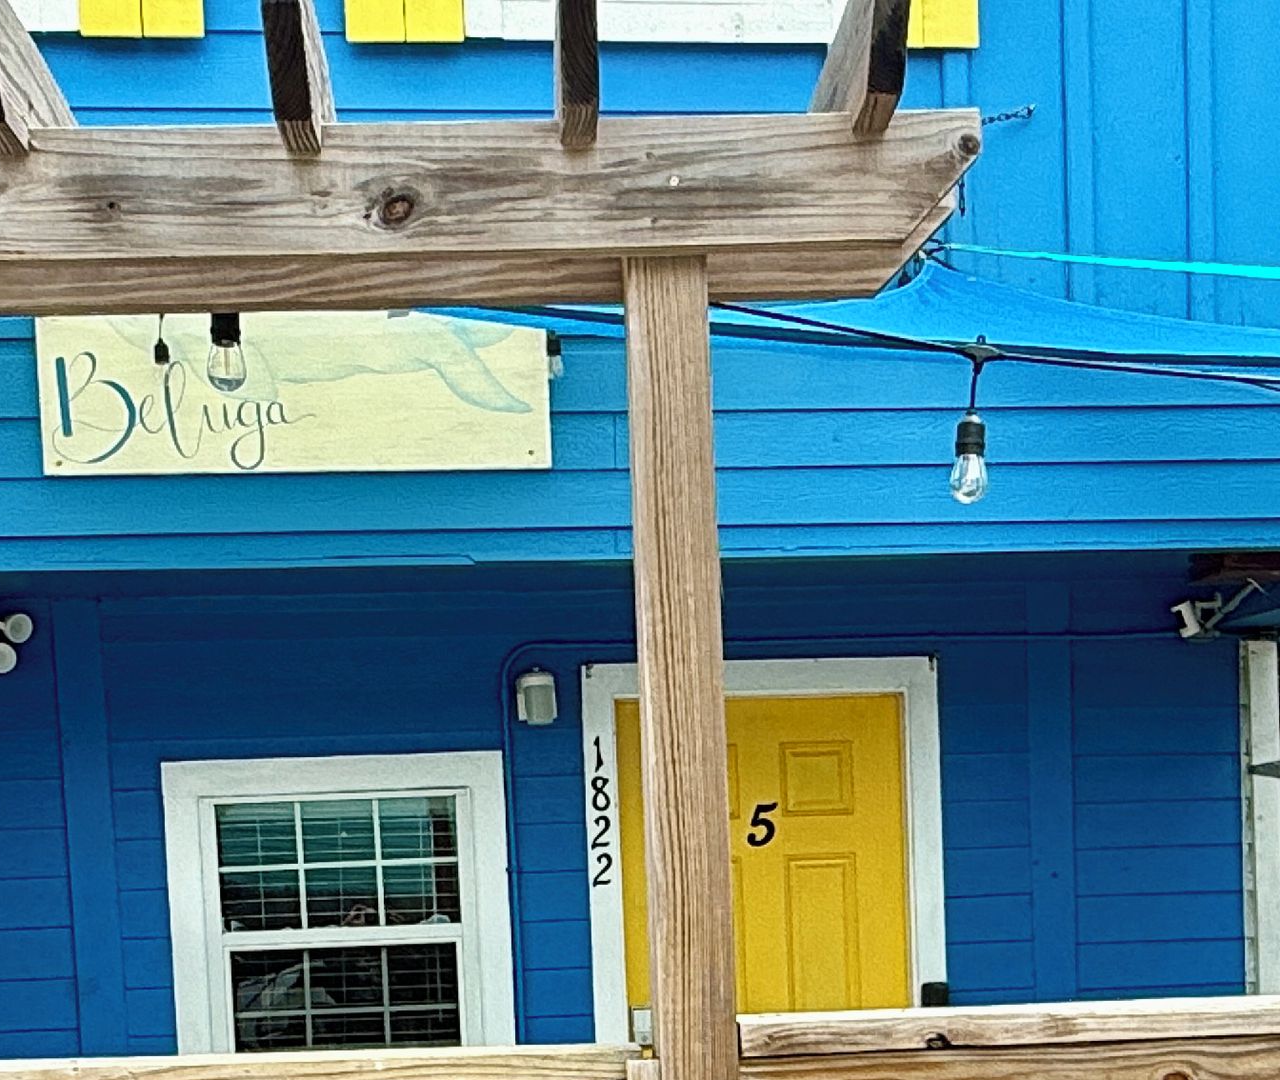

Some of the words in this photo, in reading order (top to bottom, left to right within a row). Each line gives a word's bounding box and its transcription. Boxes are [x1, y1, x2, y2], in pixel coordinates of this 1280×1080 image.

[53, 352, 317, 469] Beluga
[591, 736, 613, 888] 1822
[746, 802, 778, 847] 5
